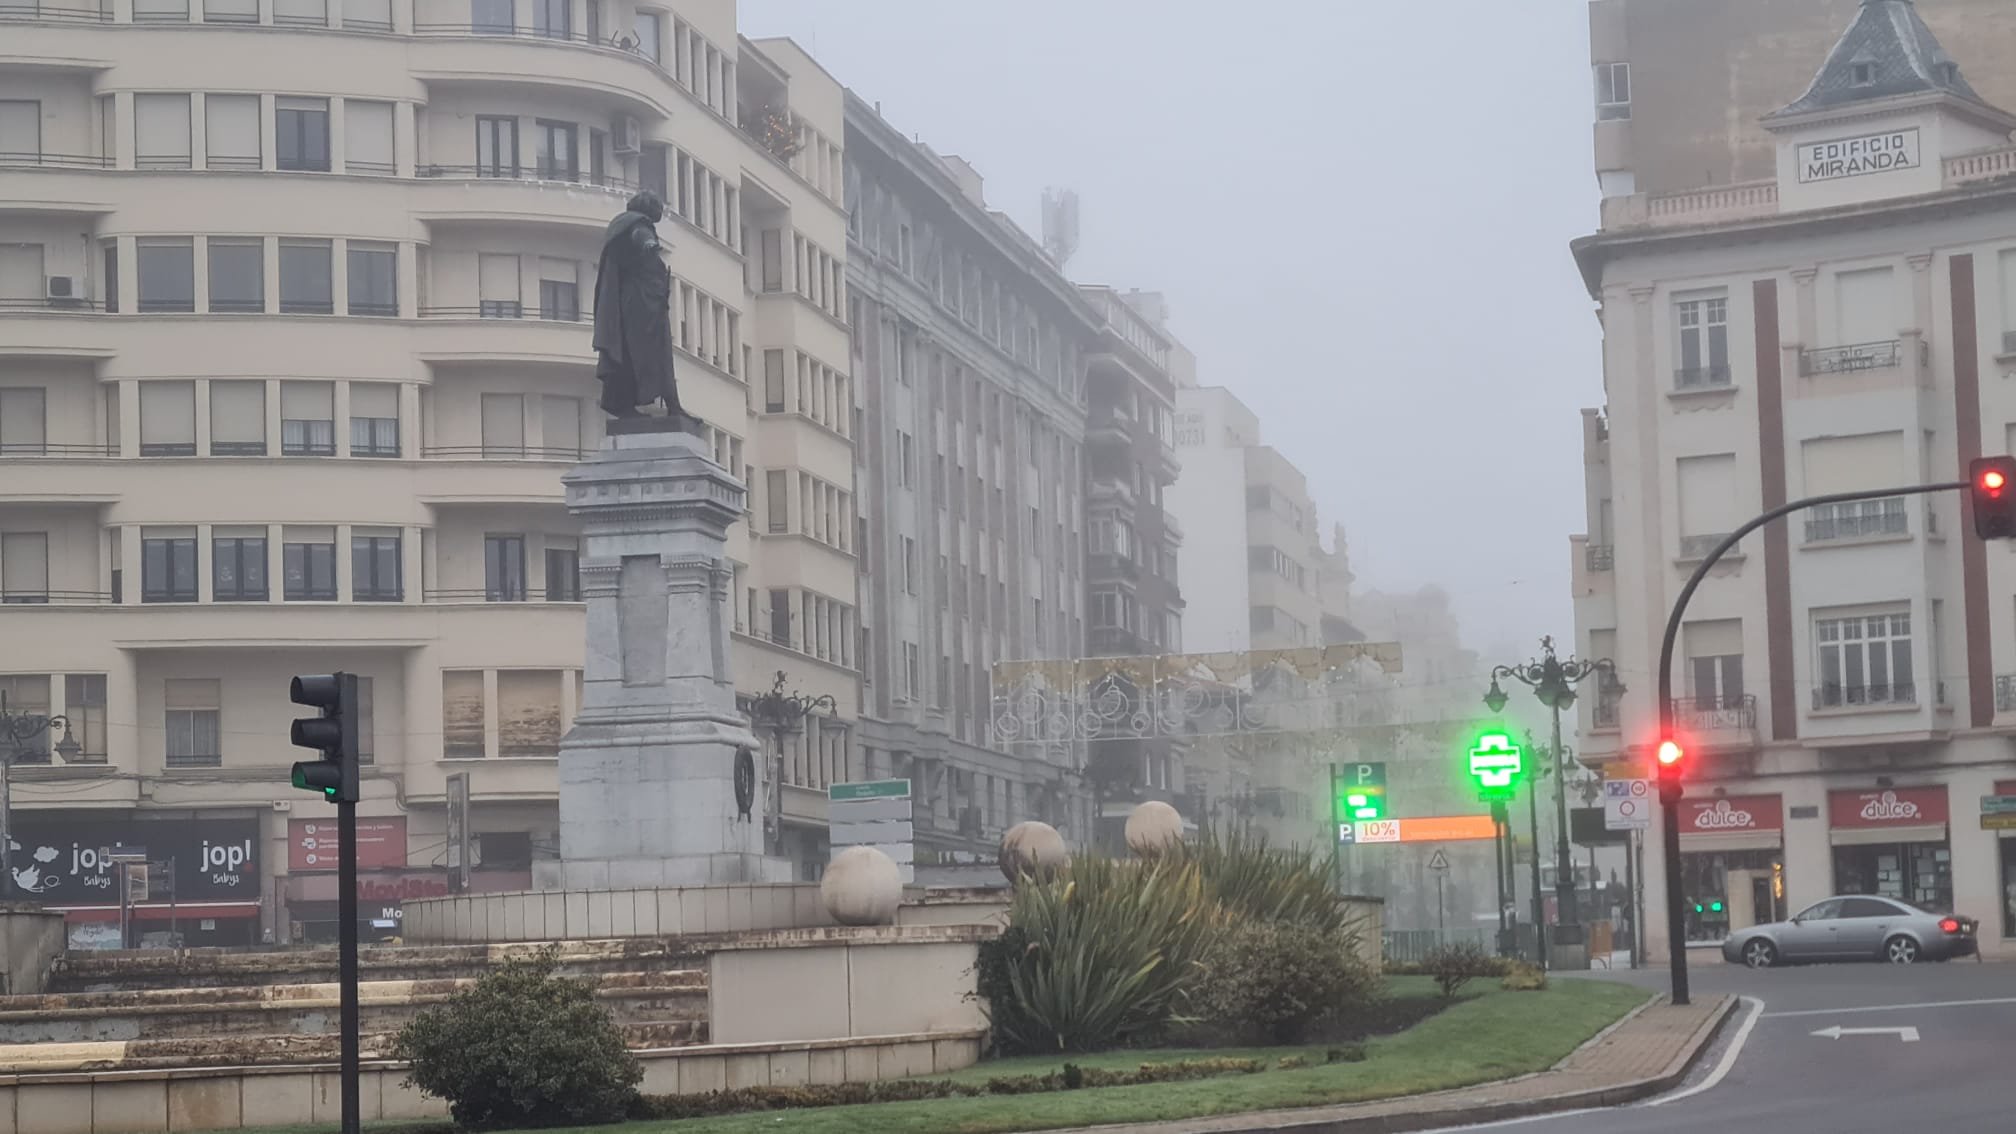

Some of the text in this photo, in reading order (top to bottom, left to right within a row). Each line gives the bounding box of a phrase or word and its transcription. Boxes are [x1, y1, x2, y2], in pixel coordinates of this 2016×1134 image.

[1813, 134, 1904, 161] EDIFICIO
[1808, 150, 1909, 179] MIRANDA
[1357, 764, 1373, 785] P
[1698, 806, 1749, 827] dulce
[1864, 797, 1914, 818] dulce
[1340, 823, 1352, 840] P
[1363, 821, 1396, 837] 10%
[200, 839, 254, 873] jop!
[212, 872, 240, 887] Babys
